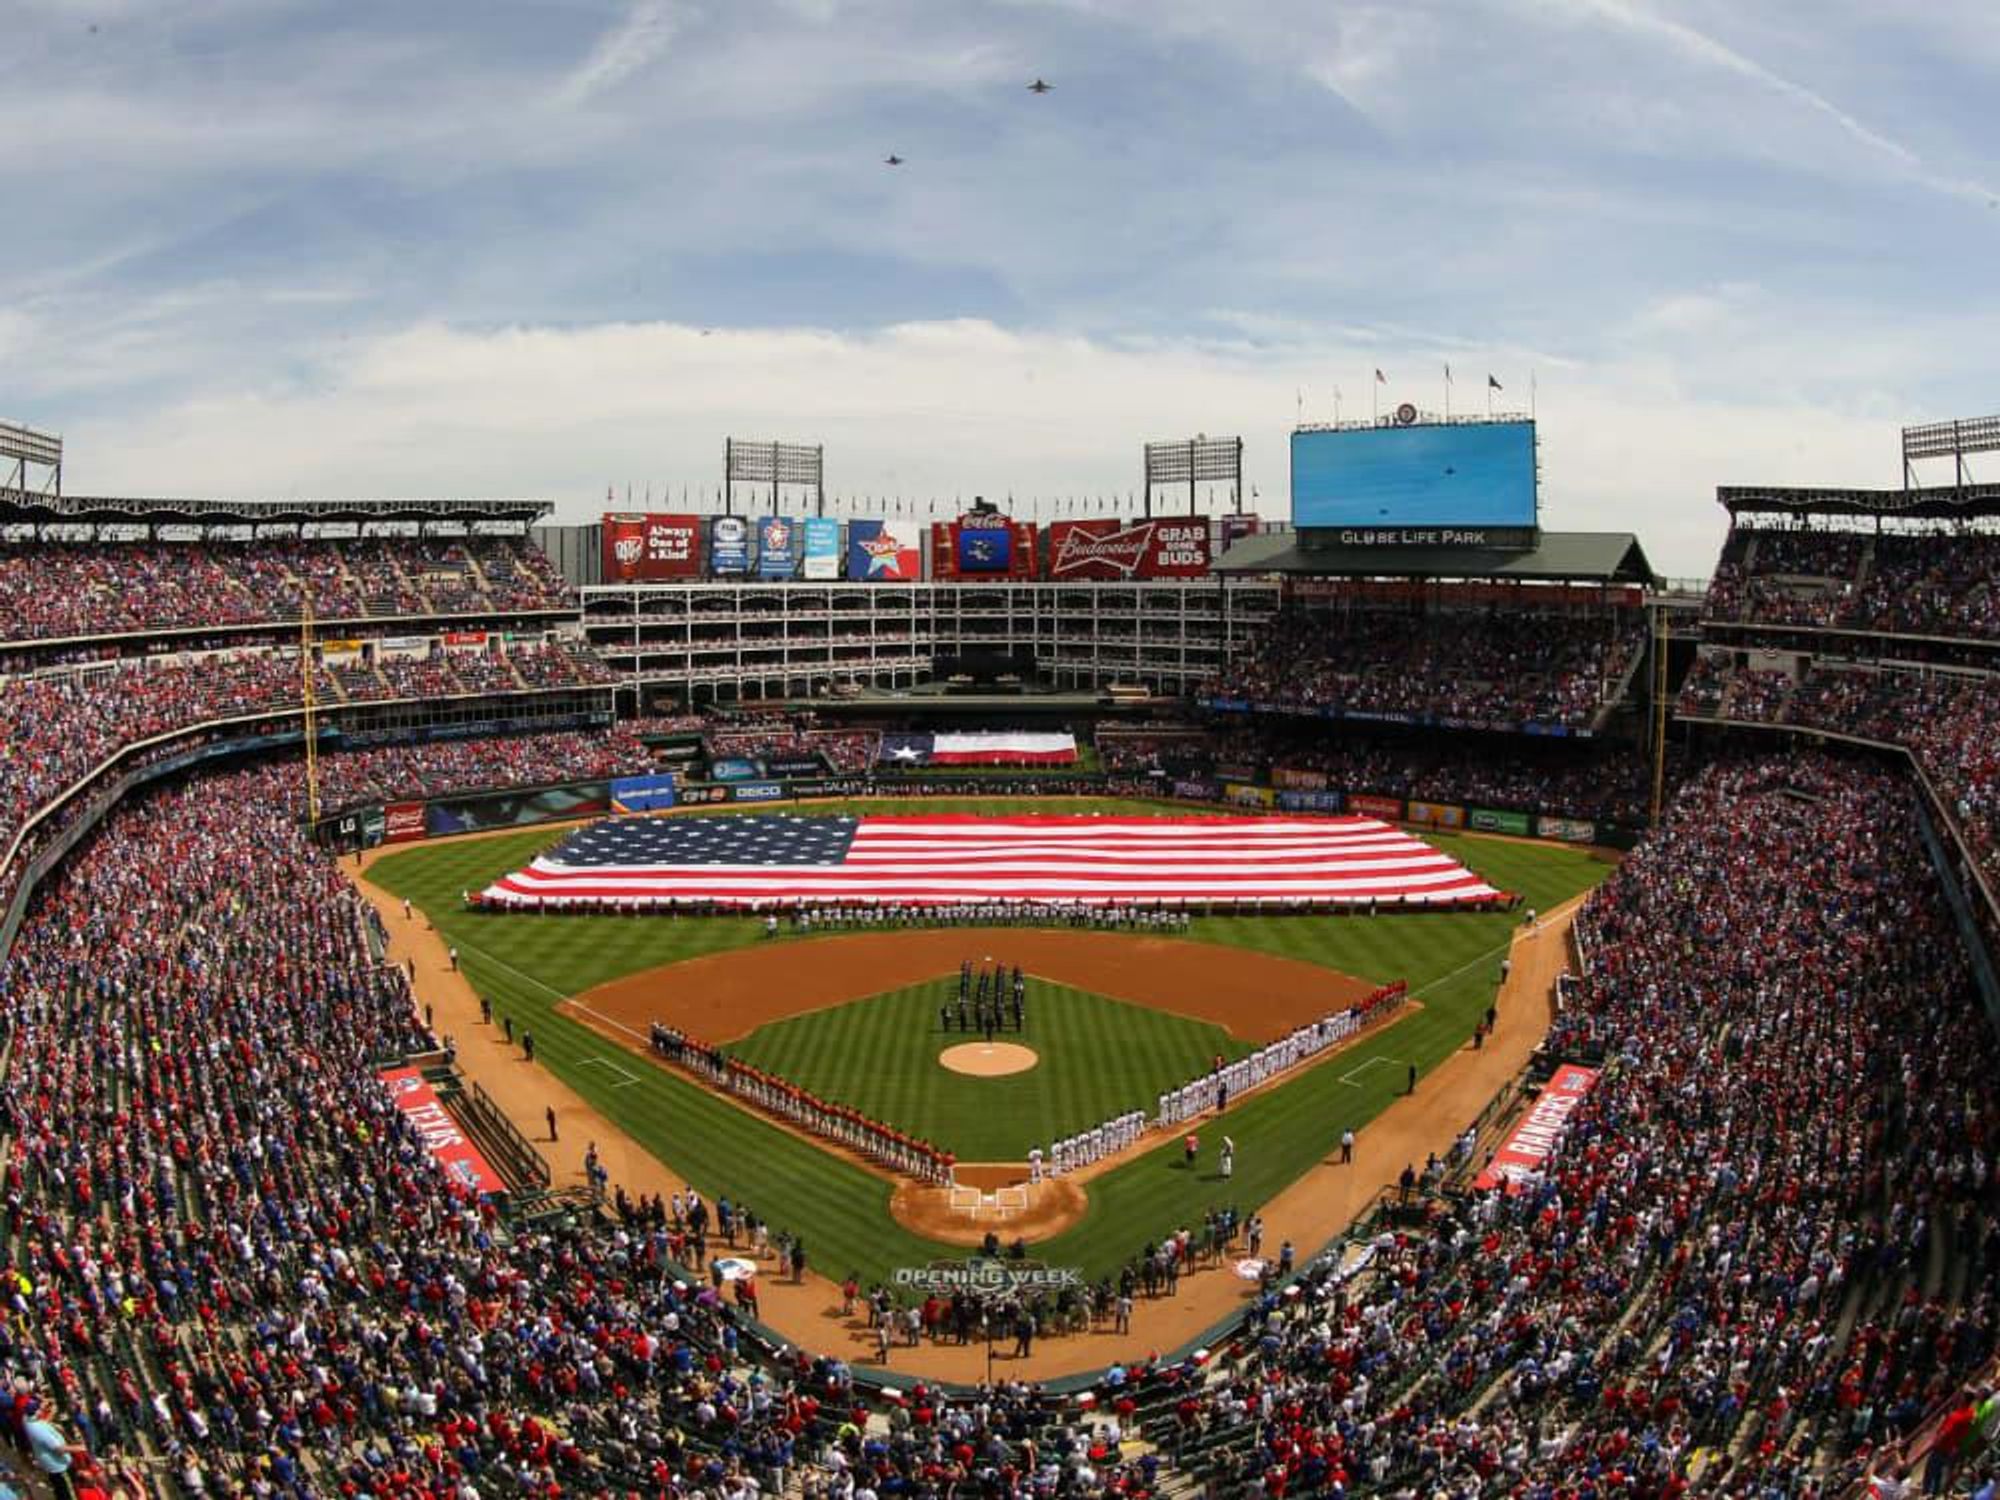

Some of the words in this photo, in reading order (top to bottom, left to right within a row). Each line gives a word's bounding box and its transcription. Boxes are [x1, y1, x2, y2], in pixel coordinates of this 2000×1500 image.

[650, 526, 693, 538] Always
[1158, 527, 1205, 541] GRAB
[1402, 529, 1437, 544] LIFE
[1441, 529, 1486, 544] PARK
[649, 537, 673, 548] One
[676, 538, 689, 547] of
[1055, 537, 1149, 557] Budweiser
[658, 549, 688, 560] Kind
[1158, 551, 1205, 566] BUDS
[736, 786, 780, 797] GEICO
[404, 1101, 464, 1150] TEXAS
[1508, 1092, 1579, 1156] RANGERS
[895, 1268, 1004, 1284] OPENING
[1005, 1268, 1082, 1285] WEEK
